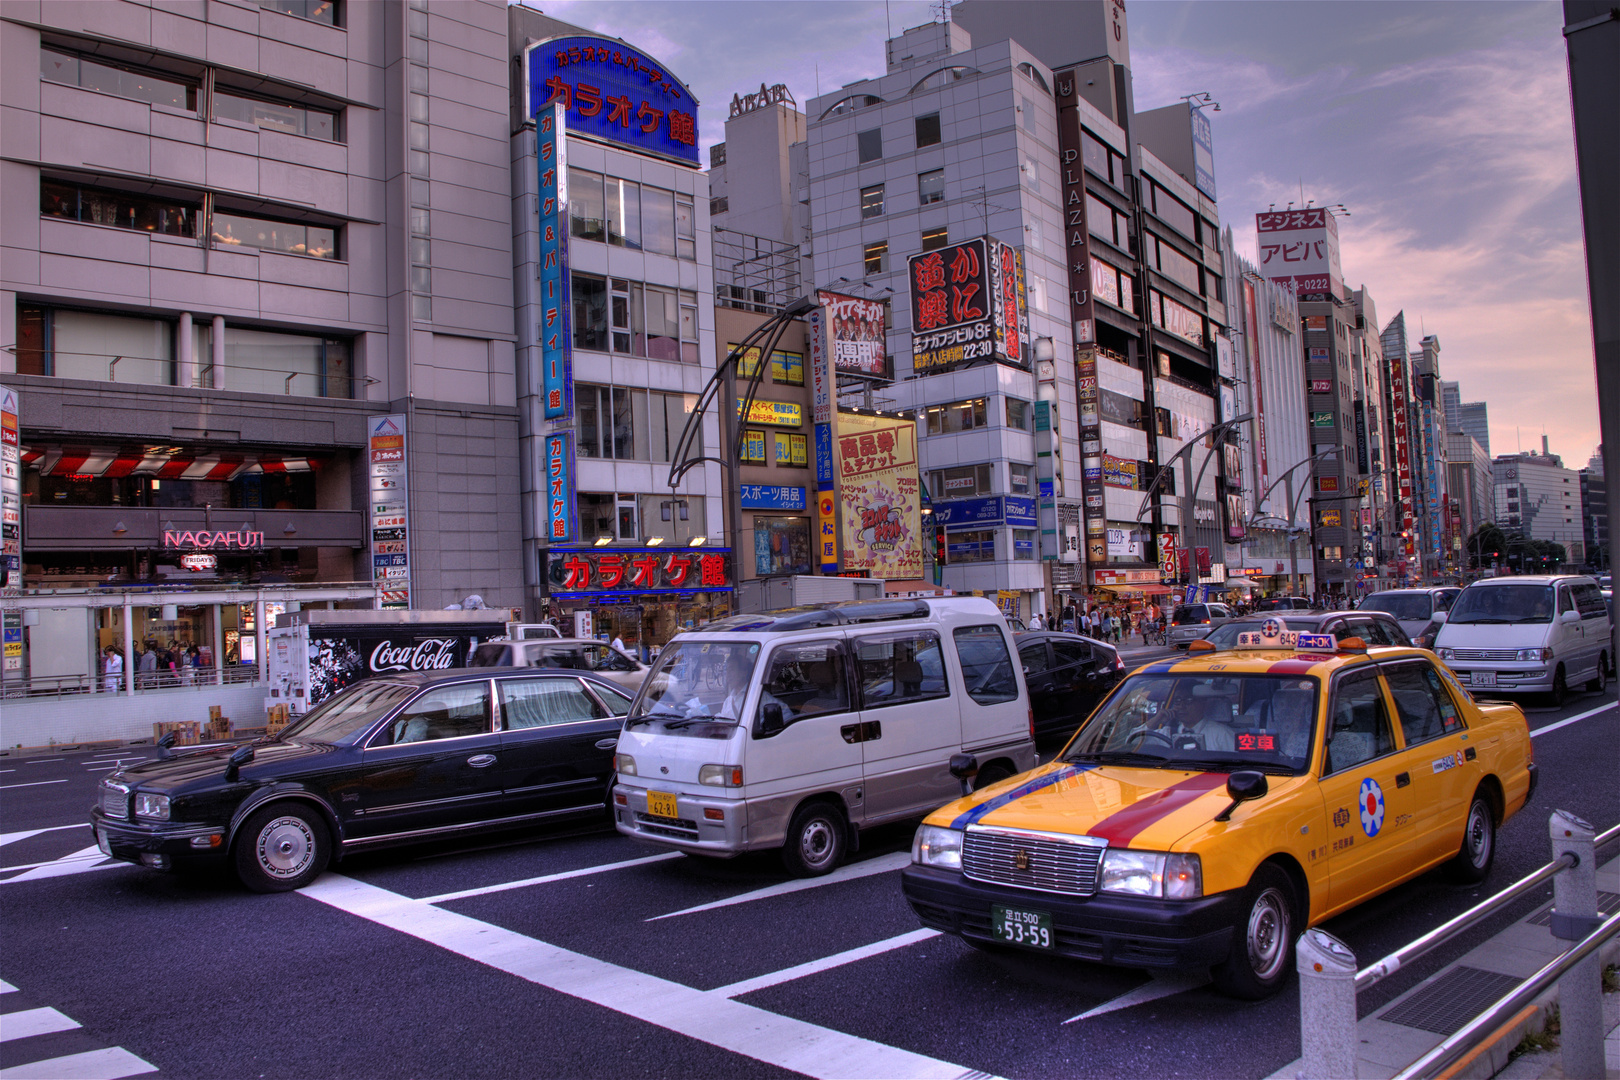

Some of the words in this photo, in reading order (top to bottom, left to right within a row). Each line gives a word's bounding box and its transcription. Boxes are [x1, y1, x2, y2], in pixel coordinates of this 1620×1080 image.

[546, 76, 695, 146] カラオケ館
[1063, 149, 1084, 247] PLAZA
[1258, 212, 1324, 230] ビジネス
[1261, 240, 1324, 264] アビバ
[839, 431, 895, 460] 商品券
[843, 453, 896, 473] &チケット
[550, 438, 566, 538] カラオケ館
[741, 485, 800, 501] スポーツ用品
[165, 530, 264, 547] NAGAFUJI
[822, 521, 834, 557] 松屋
[871, 542, 894, 551] SERVICE
[563, 554, 725, 590] カラオケ館
[1238, 733, 1274, 751] 空車
[653, 801, 675, 816] 62-81
[1004, 921, 1050, 947] 53-59
